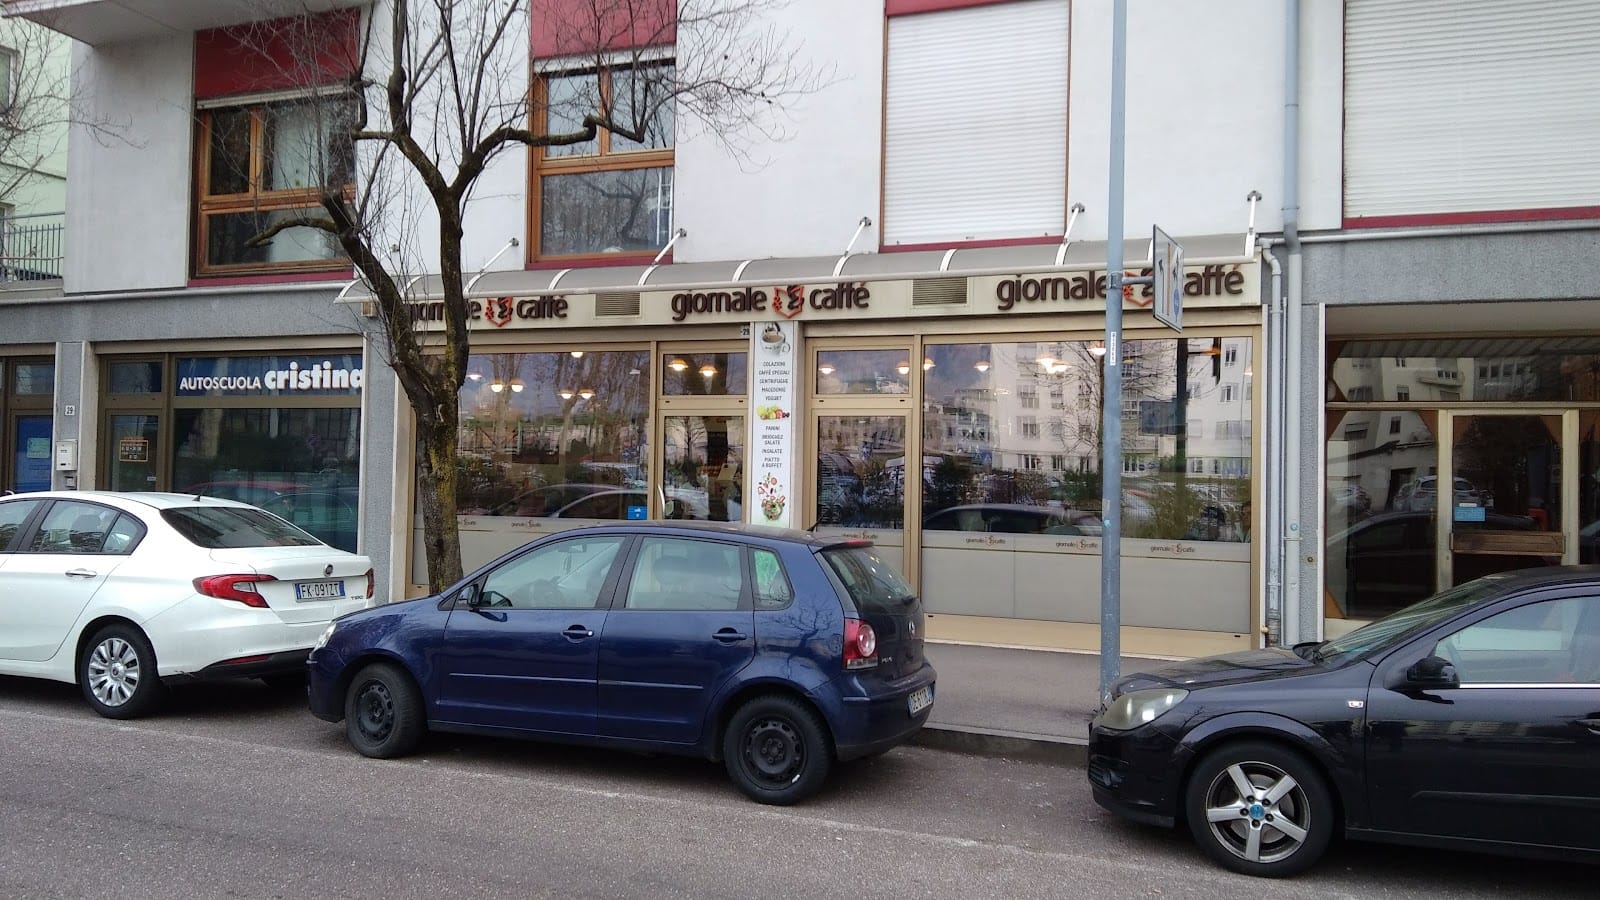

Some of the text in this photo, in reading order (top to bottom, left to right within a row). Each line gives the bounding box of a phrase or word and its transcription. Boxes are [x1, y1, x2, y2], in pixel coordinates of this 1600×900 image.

[1182, 263, 1245, 296] affé
[671, 287, 767, 321] giornale
[179, 376, 262, 390] AUTOSCUOLA
